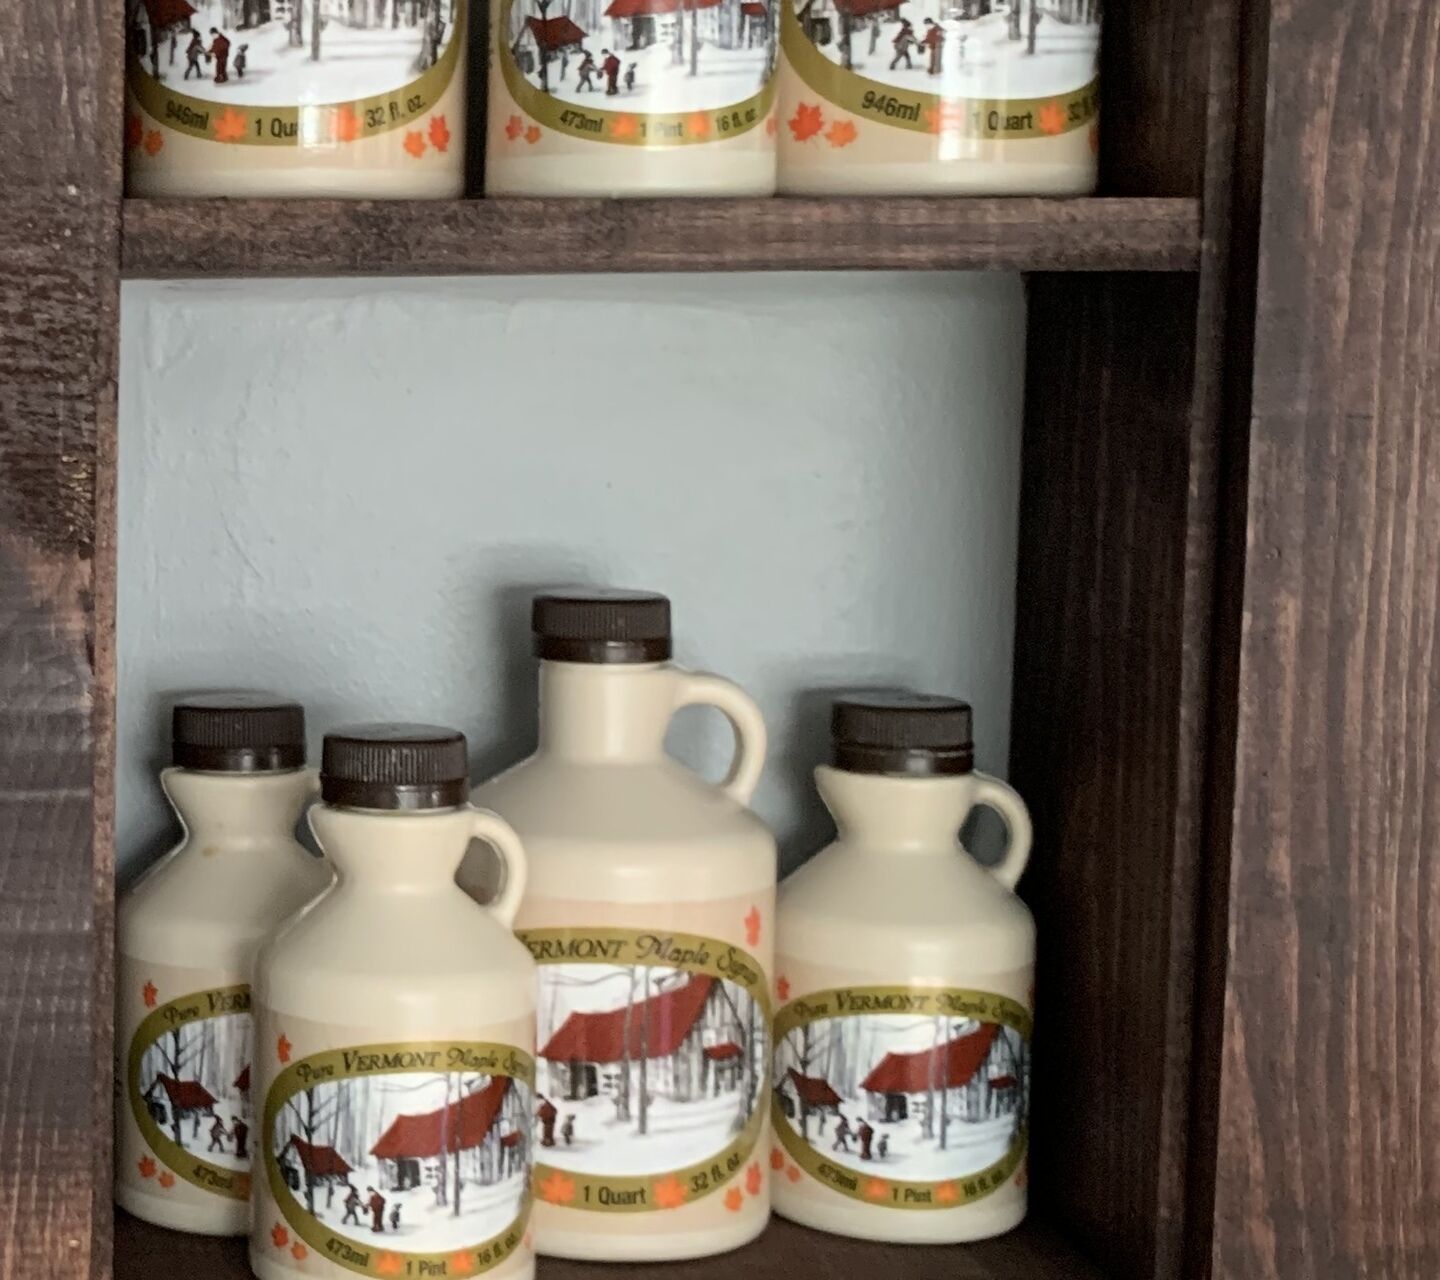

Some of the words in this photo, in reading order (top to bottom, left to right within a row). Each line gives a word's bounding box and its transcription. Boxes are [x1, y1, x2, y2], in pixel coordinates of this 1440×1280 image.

[862, 91, 920, 122] 946ml
[255, 118, 262, 137] 1
[365, 108, 386, 130] 32
[558, 109, 604, 133] 473ml
[635, 934, 710, 966] Maple
[836, 989, 931, 1011] VERMONT
[296, 1062, 334, 1084] Pure
[342, 1048, 441, 1074] VERMONT
[583, 1184, 590, 1202] 1
[599, 1186, 647, 1206] Quart
[406, 1261, 413, 1276] 1
[418, 1259, 448, 1278] Pint
